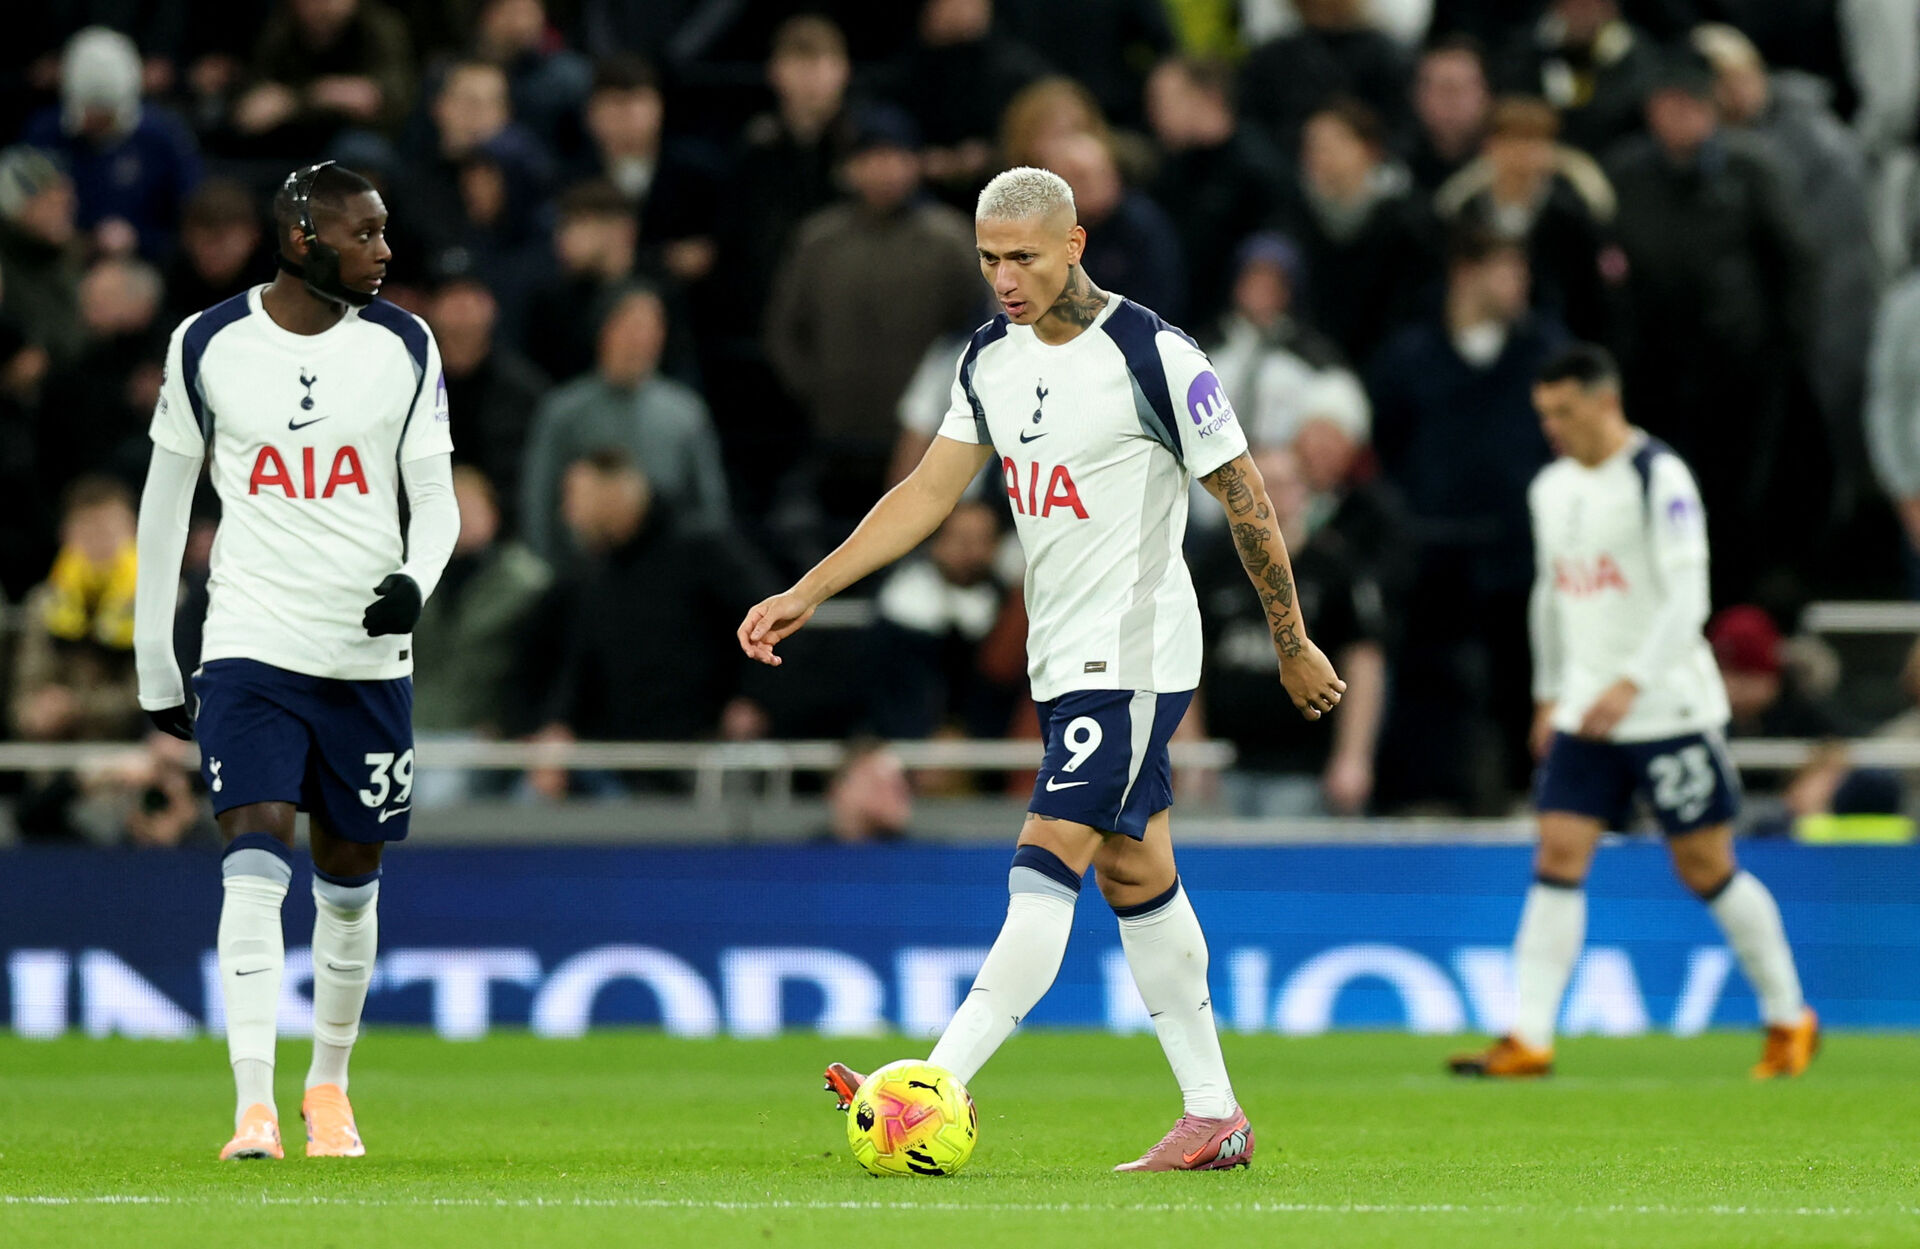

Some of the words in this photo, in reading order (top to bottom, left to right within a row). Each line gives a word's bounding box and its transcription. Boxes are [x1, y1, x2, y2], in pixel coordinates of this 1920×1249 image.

[1198, 405, 1232, 439] krake
[248, 445, 369, 499] AIA
[1003, 456, 1090, 520] AIA
[1061, 716, 1103, 773] 9
[358, 748, 414, 808] 39
[1647, 746, 1716, 811] 23
